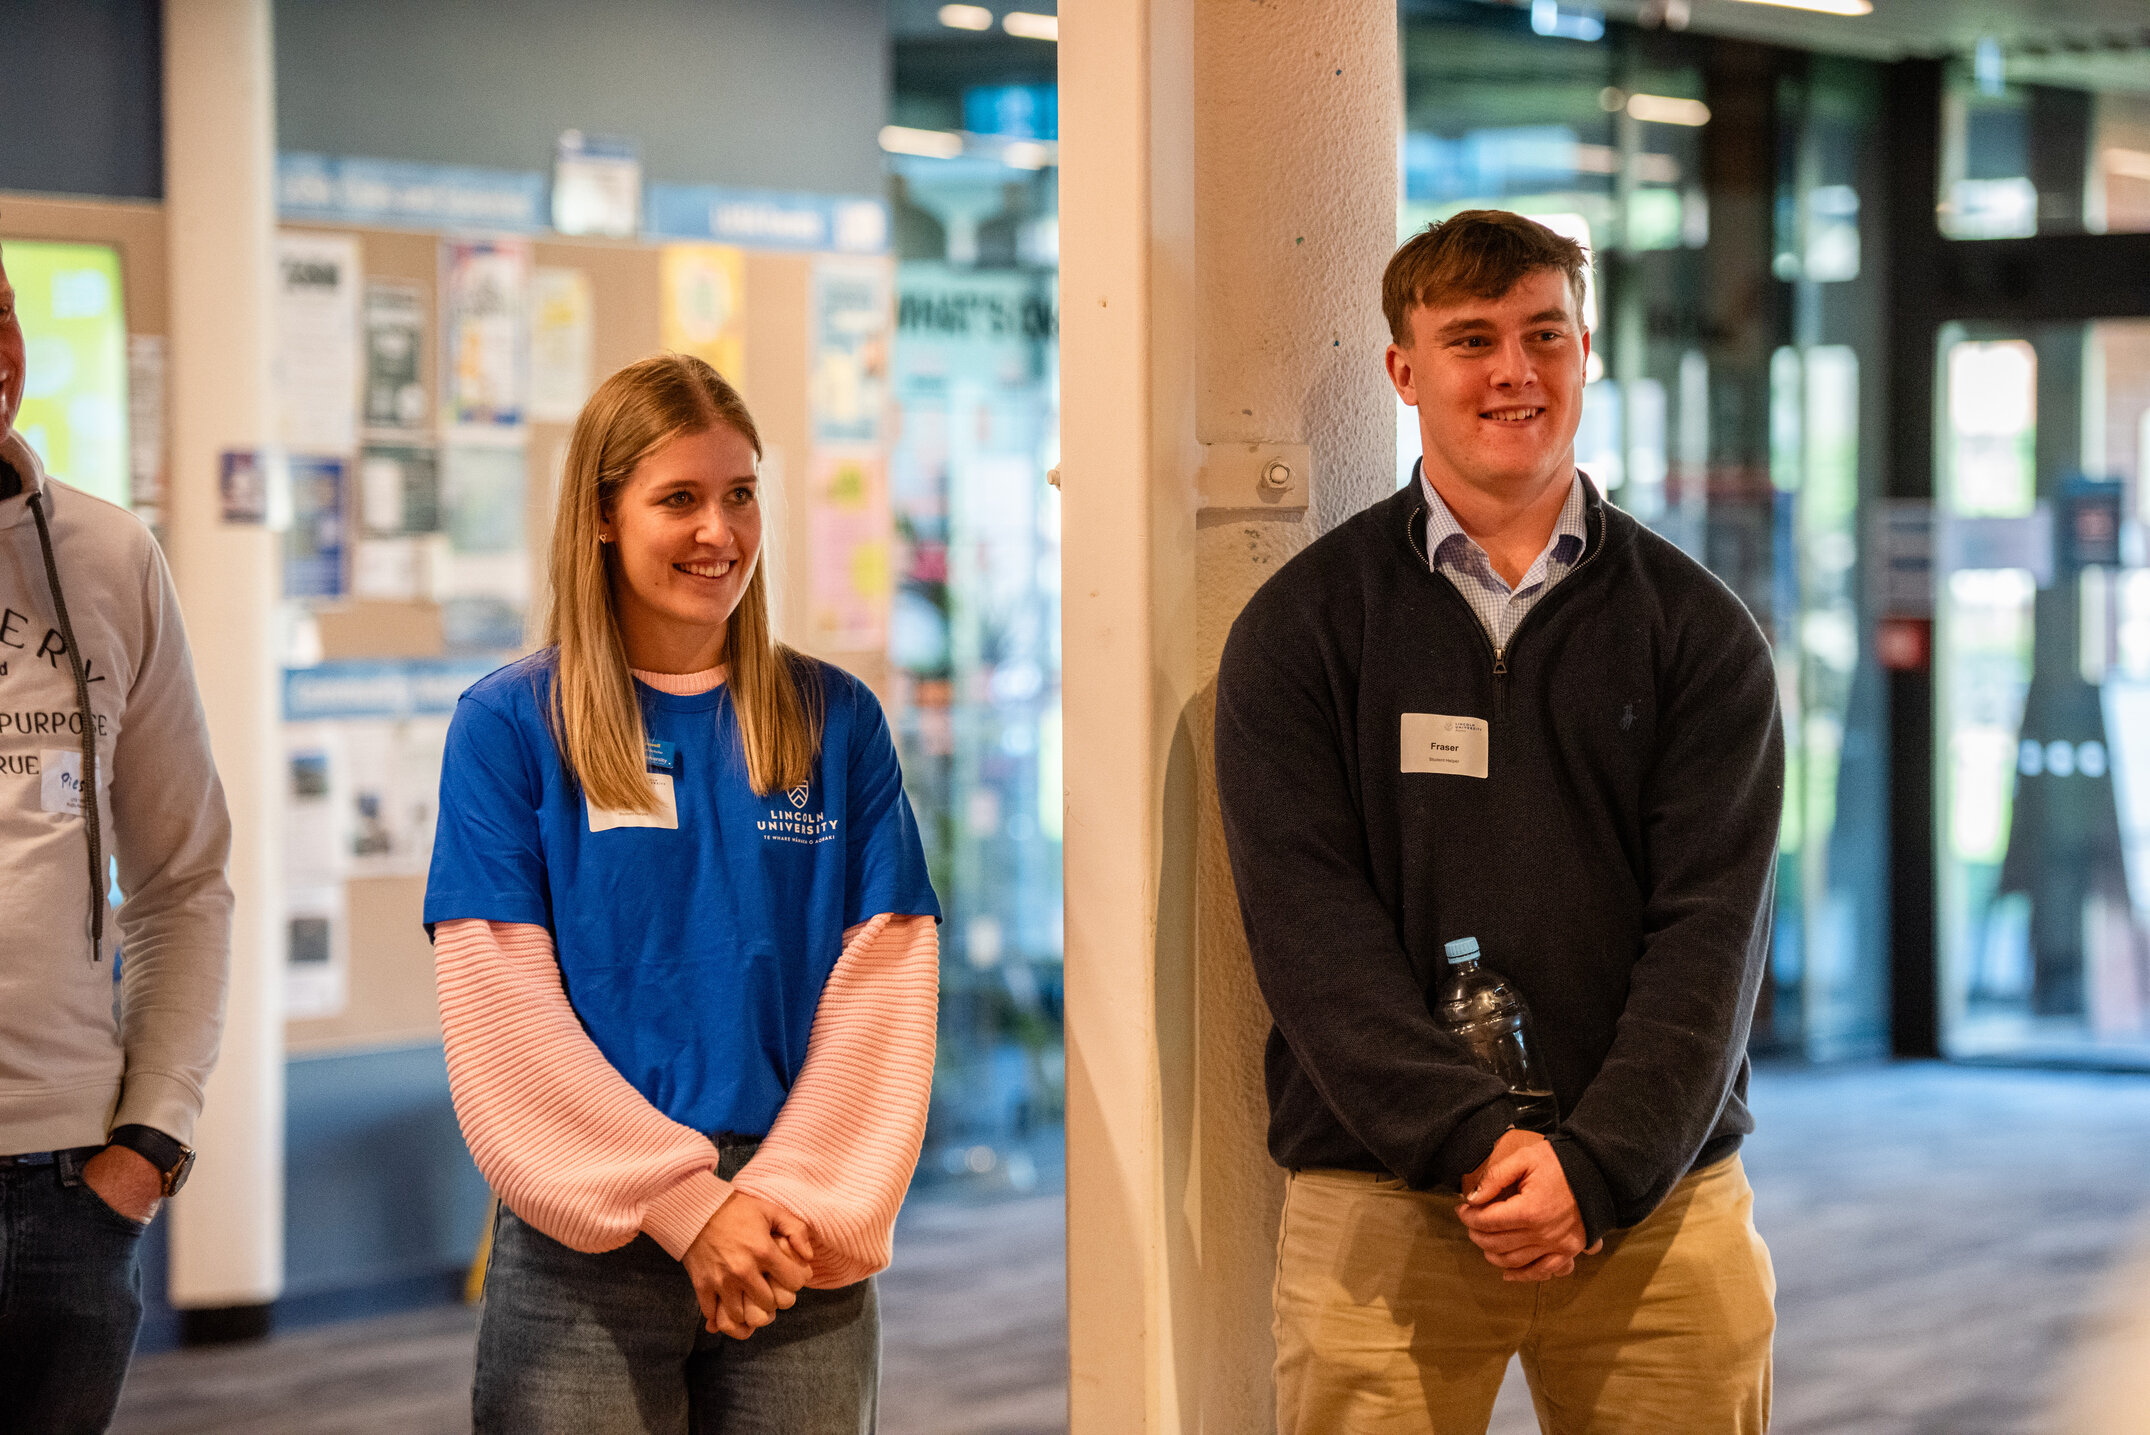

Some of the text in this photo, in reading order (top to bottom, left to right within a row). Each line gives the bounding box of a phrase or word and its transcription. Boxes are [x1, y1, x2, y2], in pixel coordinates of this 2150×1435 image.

[1430, 742, 1459, 751] Fraser
[770, 810, 824, 823] LINCOLN
[757, 820, 838, 835] UNIVERSITY
